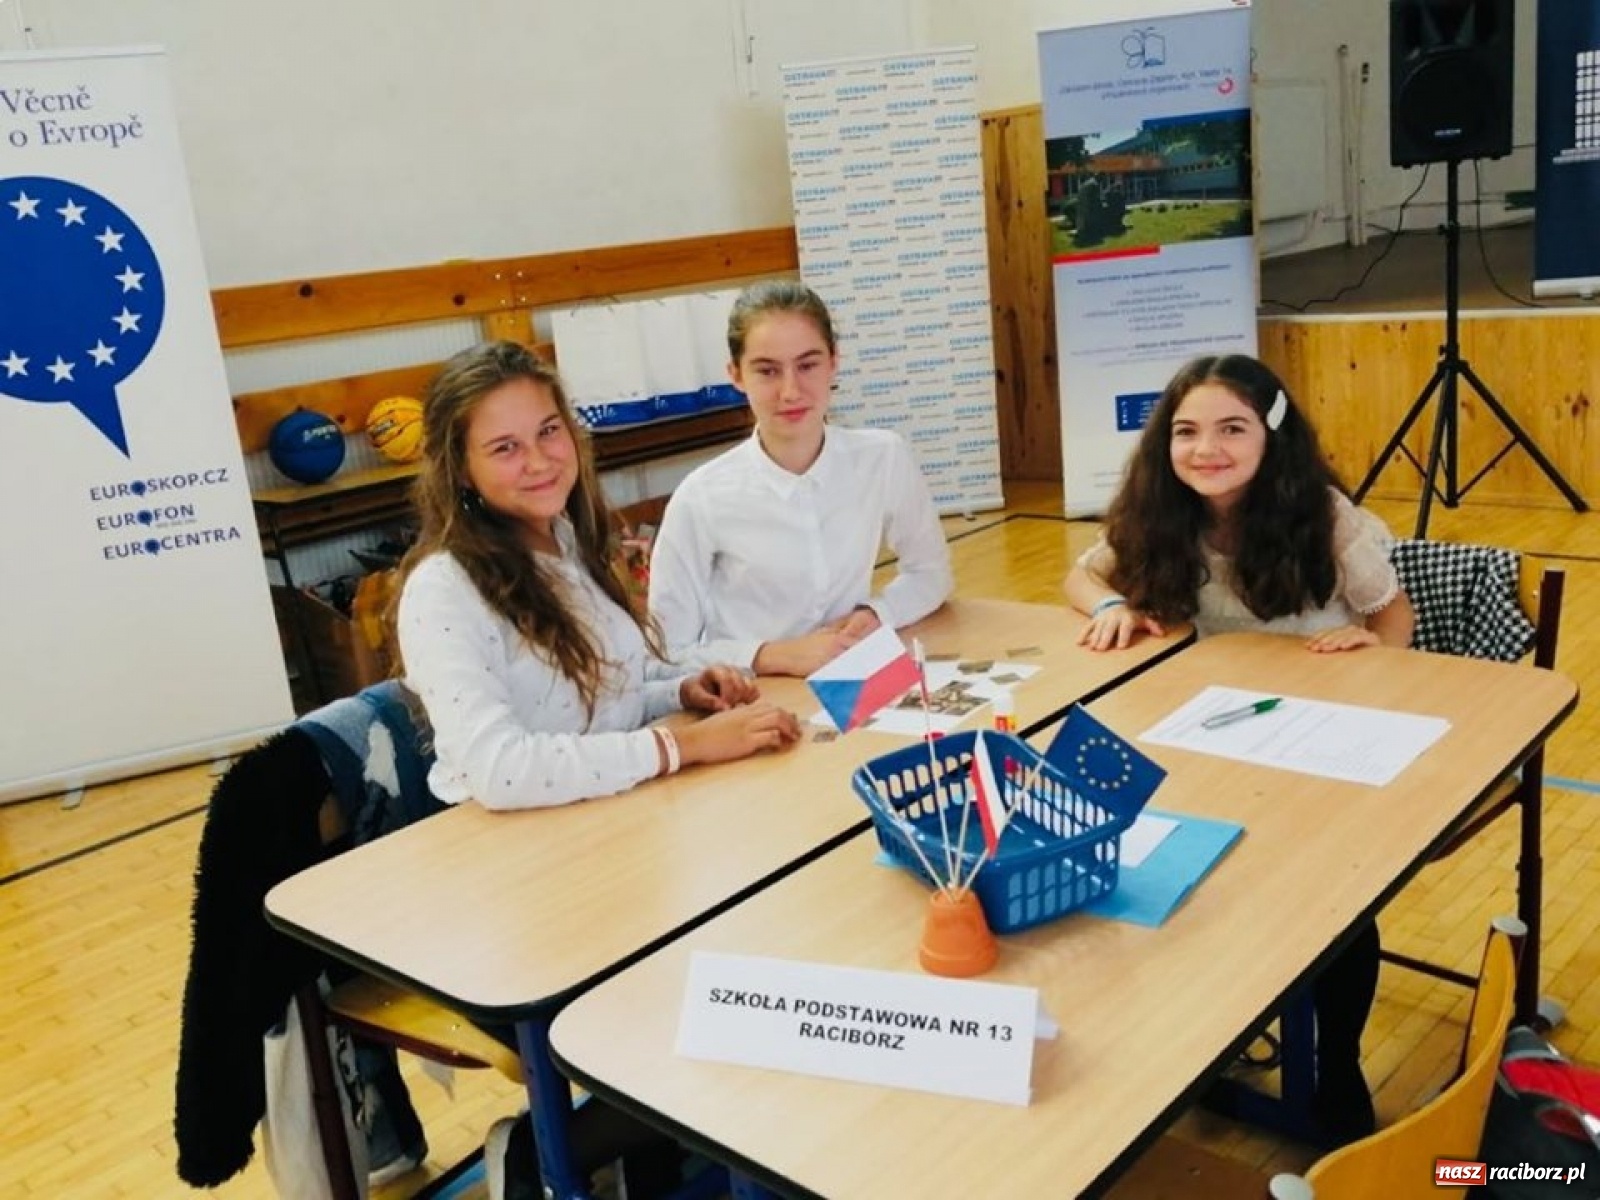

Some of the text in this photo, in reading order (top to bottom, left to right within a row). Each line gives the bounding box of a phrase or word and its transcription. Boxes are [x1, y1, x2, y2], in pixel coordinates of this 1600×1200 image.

[0, 85, 92, 115] Věcně
[9, 114, 145, 149] o Evropě
[90, 467, 229, 502] EUROSKOP.CZ
[97, 504, 195, 531] EUROFON
[103, 525, 241, 561] EUROCENTRA
[708, 987, 1013, 1042] SZKOŁA PODSTAWOWA NR 13
